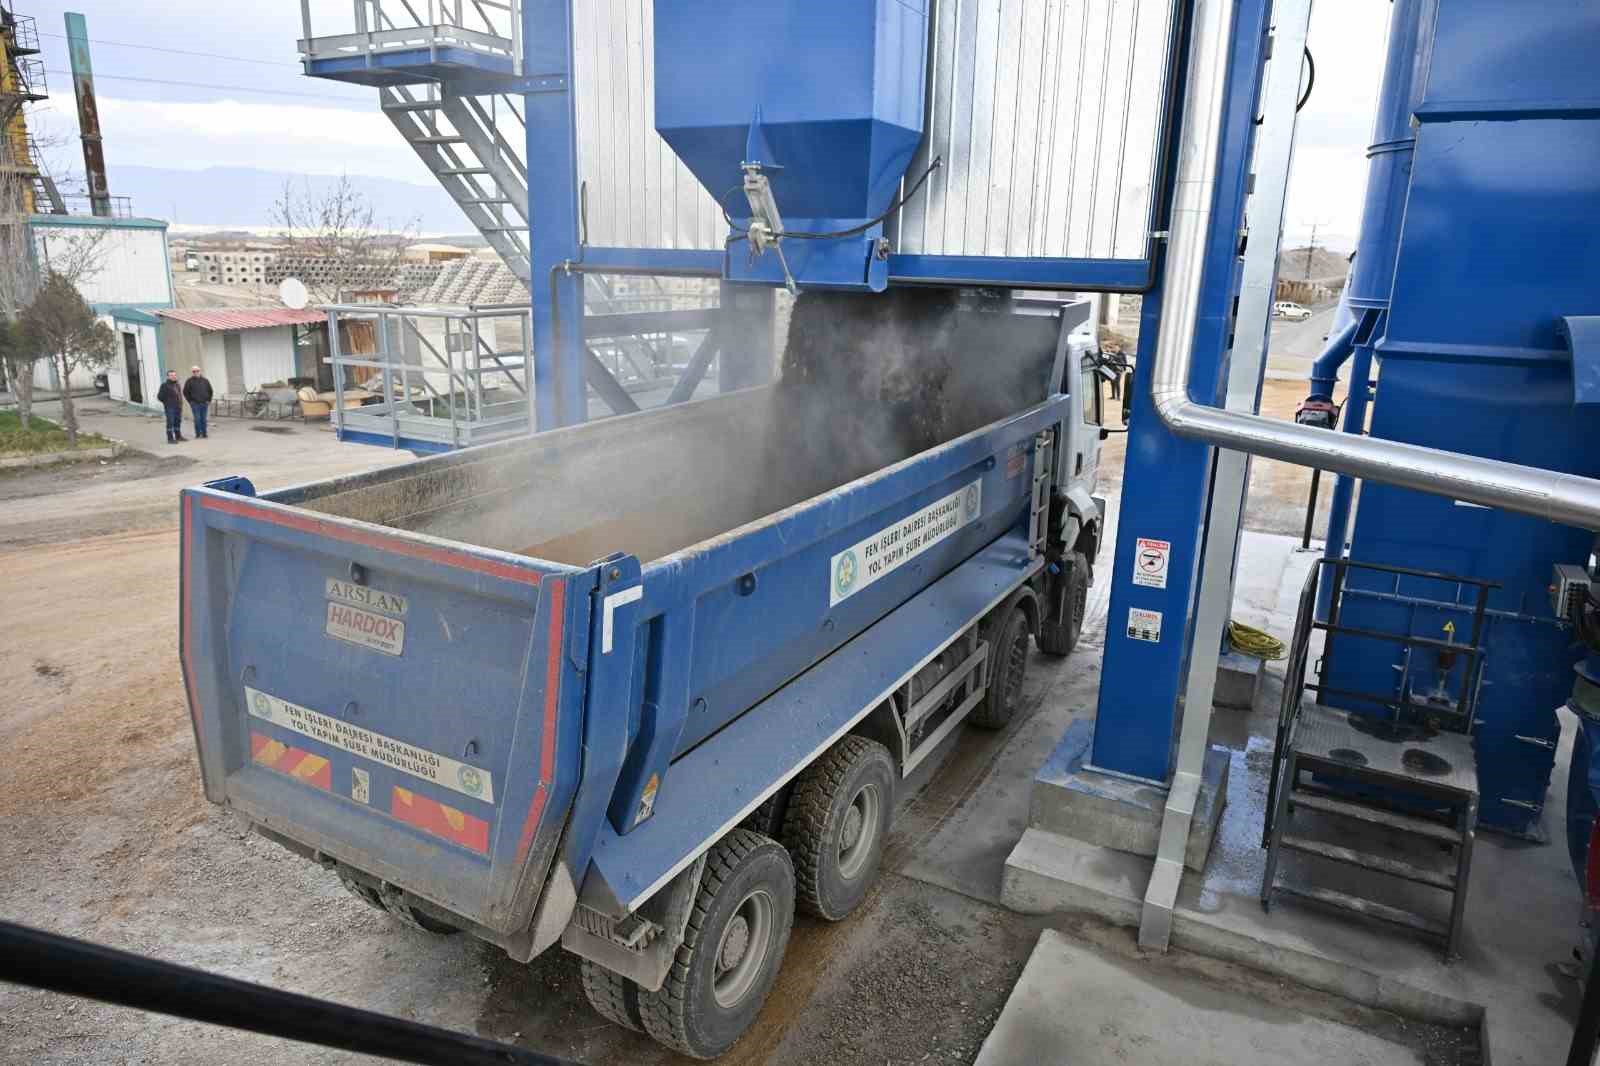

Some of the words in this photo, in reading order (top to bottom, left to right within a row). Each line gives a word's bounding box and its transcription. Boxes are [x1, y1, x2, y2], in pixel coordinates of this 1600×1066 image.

[865, 543, 878, 559] FEN
[868, 562, 882, 577] YOL
[330, 582, 403, 613] ARSLAN
[330, 605, 399, 641] HARDOX
[284, 704, 301, 719] FEN
[290, 719, 309, 733] YOL
[311, 726, 340, 743] YAPIM
